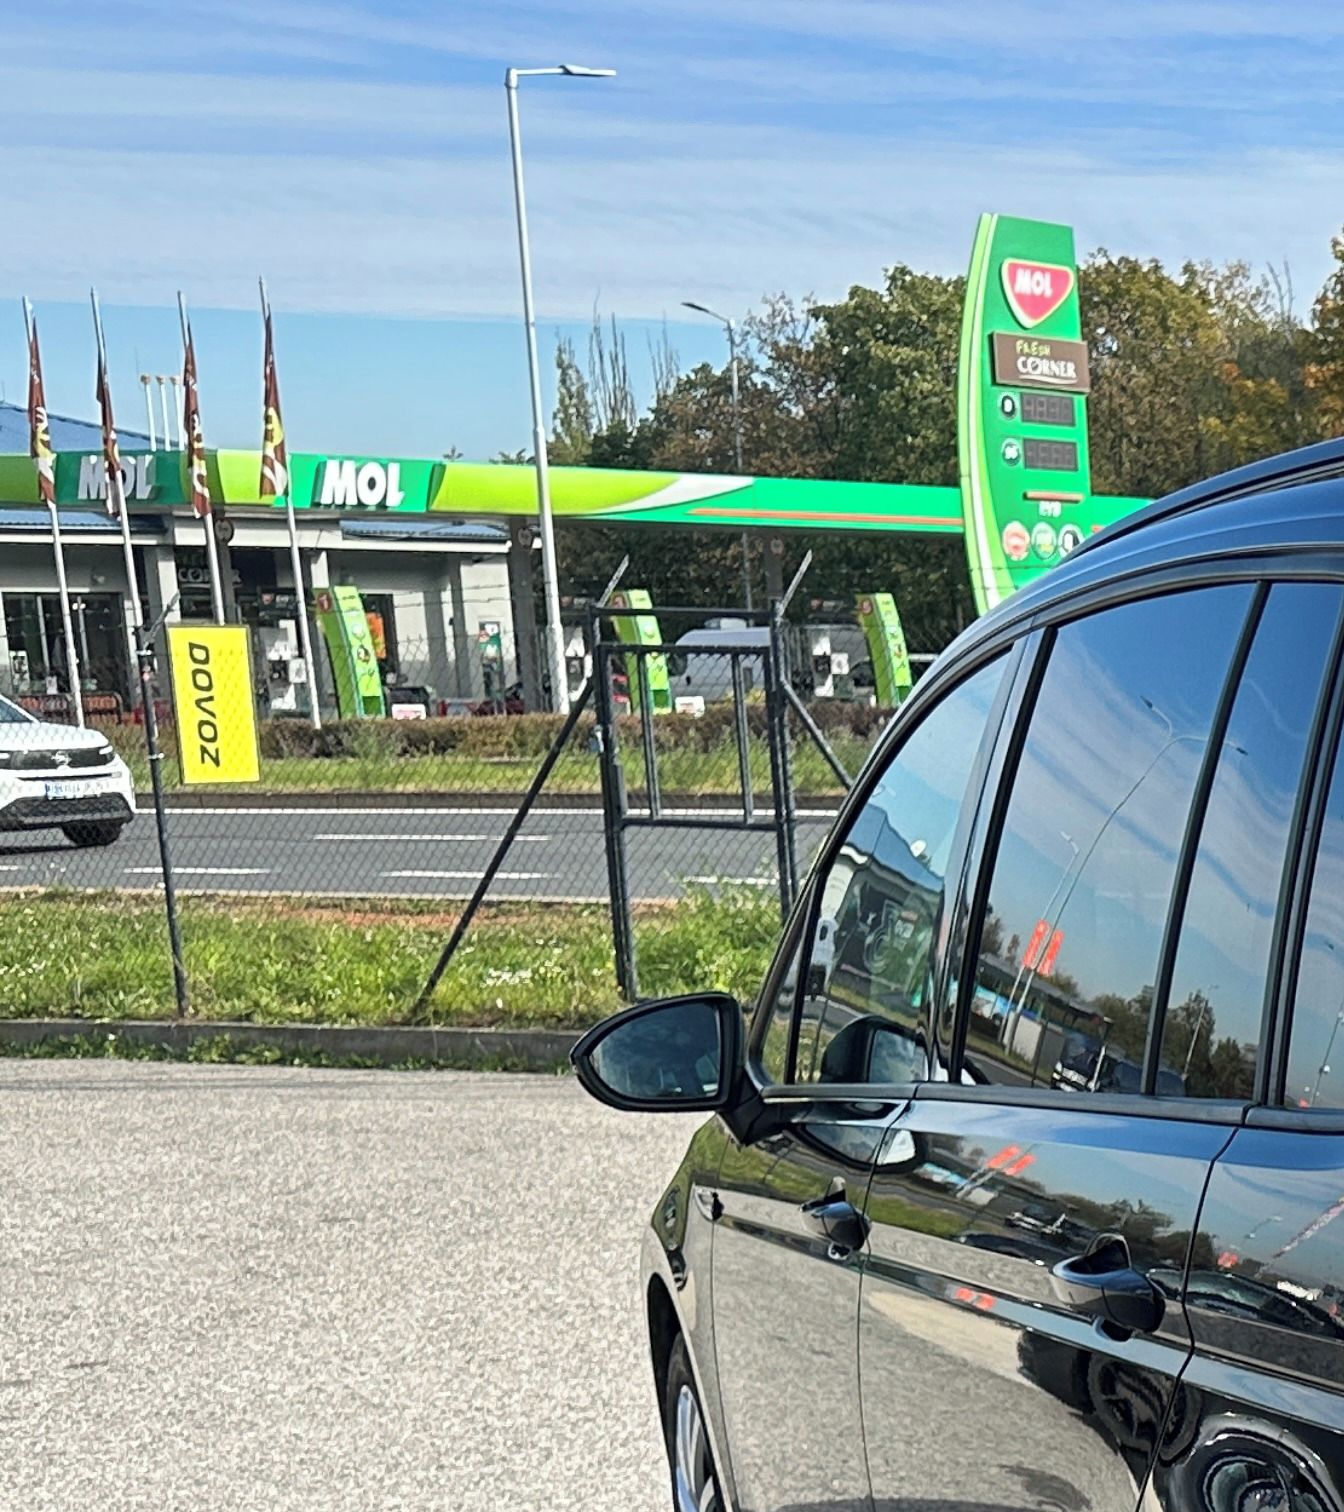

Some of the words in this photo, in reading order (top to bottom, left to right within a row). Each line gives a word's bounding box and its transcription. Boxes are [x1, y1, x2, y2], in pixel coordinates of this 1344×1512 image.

[1014, 268, 1053, 298] MOL
[1017, 356, 1077, 379] CORNER
[320, 459, 405, 507] MOL
[187, 641, 221, 768] DOVOZ
